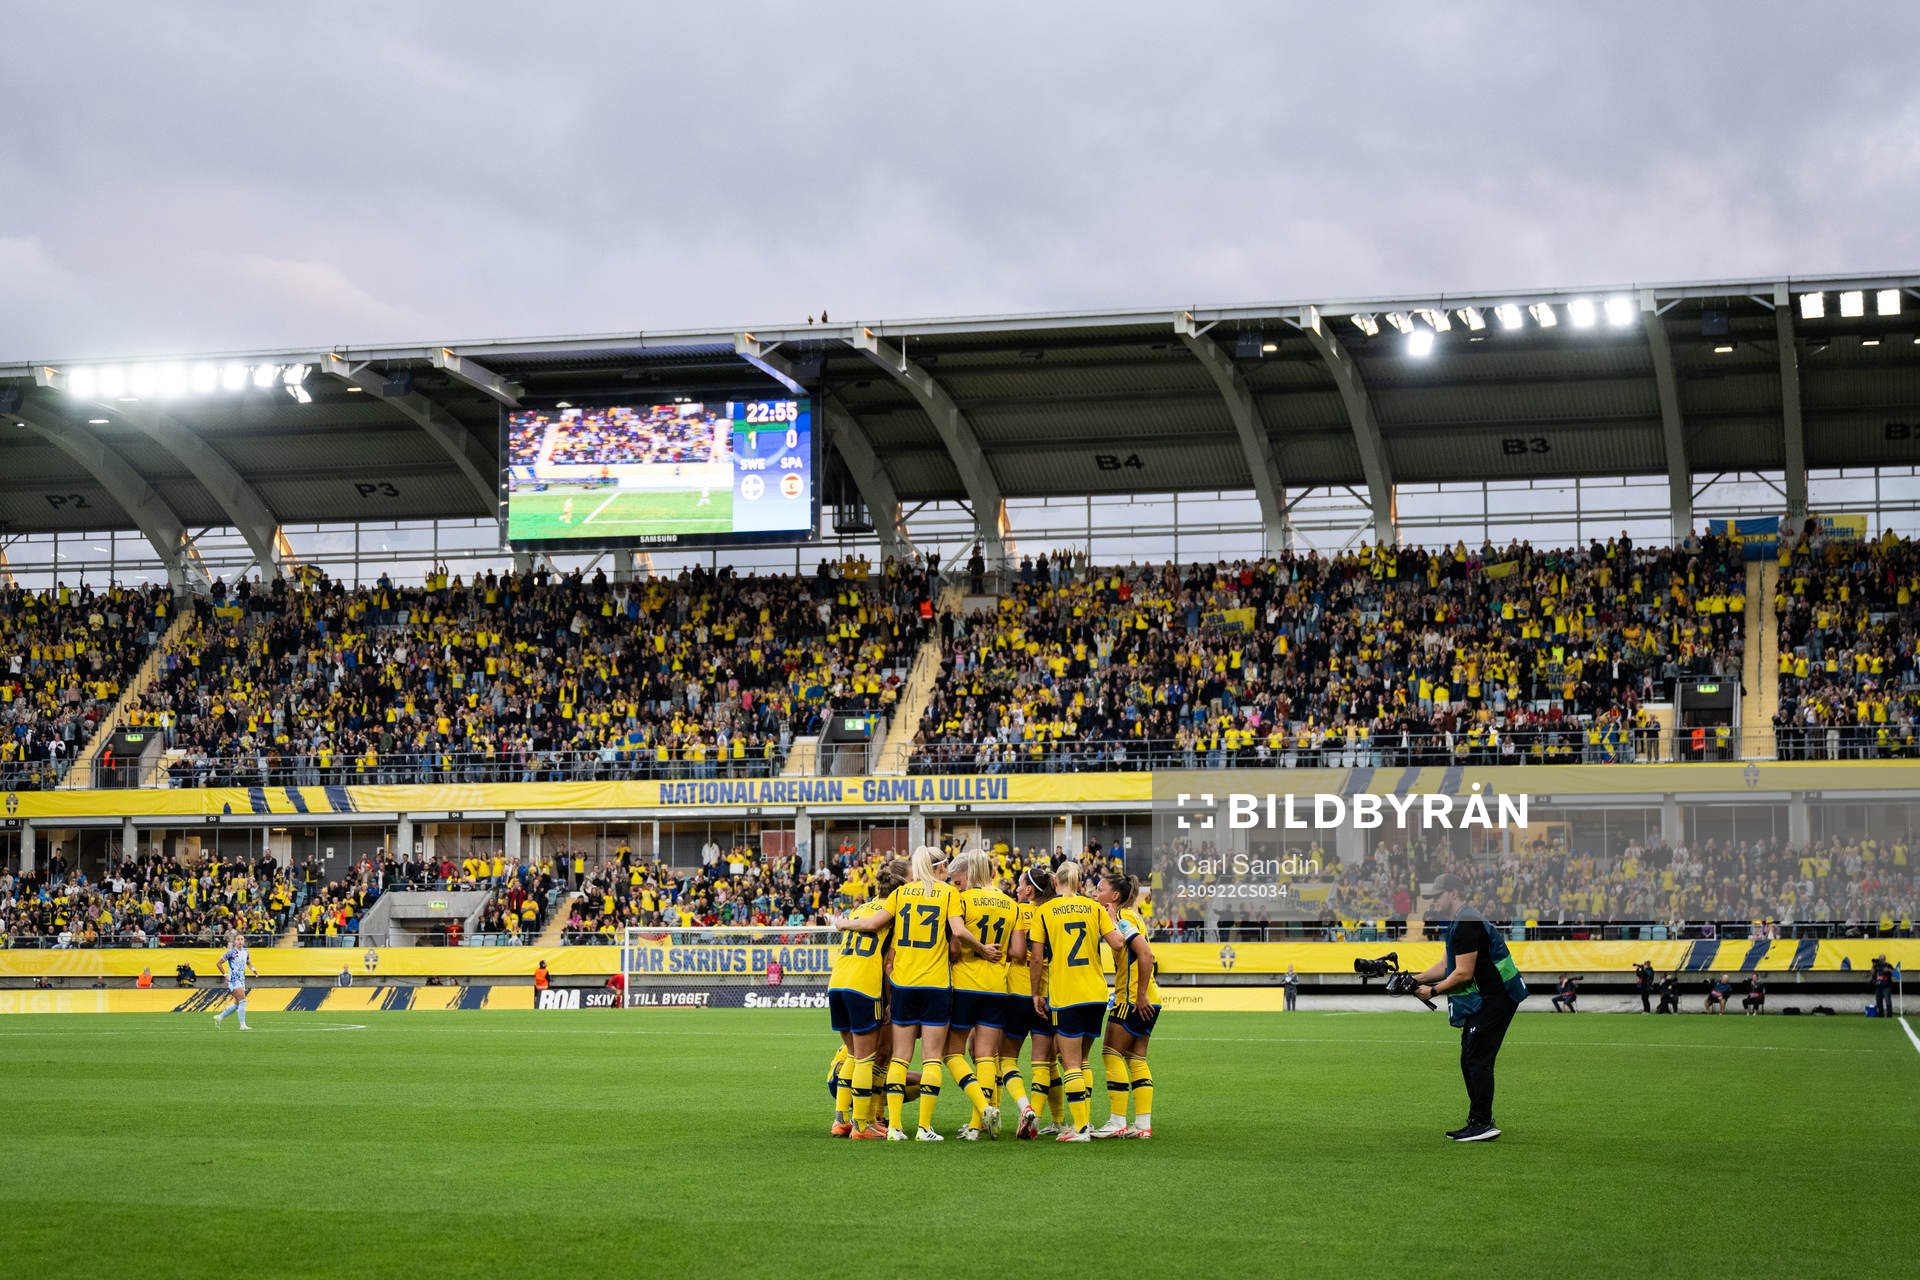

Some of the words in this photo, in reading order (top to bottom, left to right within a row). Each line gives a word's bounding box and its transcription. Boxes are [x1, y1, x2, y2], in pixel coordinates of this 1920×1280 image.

[746, 402, 798, 422] 22:55
[748, 431, 757, 450] 1
[785, 429, 798, 448] 0
[1502, 437, 1550, 455] B3
[740, 458, 766, 470] SWE
[780, 456, 803, 469] SPA
[1095, 454, 1144, 470] B4
[355, 482, 400, 498] P3
[45, 494, 93, 510] P2
[640, 534, 678, 543] SAMSUNG
[659, 780, 843, 804] NATIONALARENAN
[863, 779, 935, 802] GAMLA
[939, 777, 1008, 801] ULLEVI
[902, 887, 941, 898] ILESTDT
[897, 903, 941, 949] 13
[974, 915, 1006, 957] 11
[1063, 921, 1089, 967] 2
[669, 947, 747, 973] SKRIVS
[585, 994, 631, 1006] SKIV
[634, 993, 659, 1006] TILL
[662, 992, 710, 1005] BYGGET
[1159, 995, 1204, 1005] erryman
